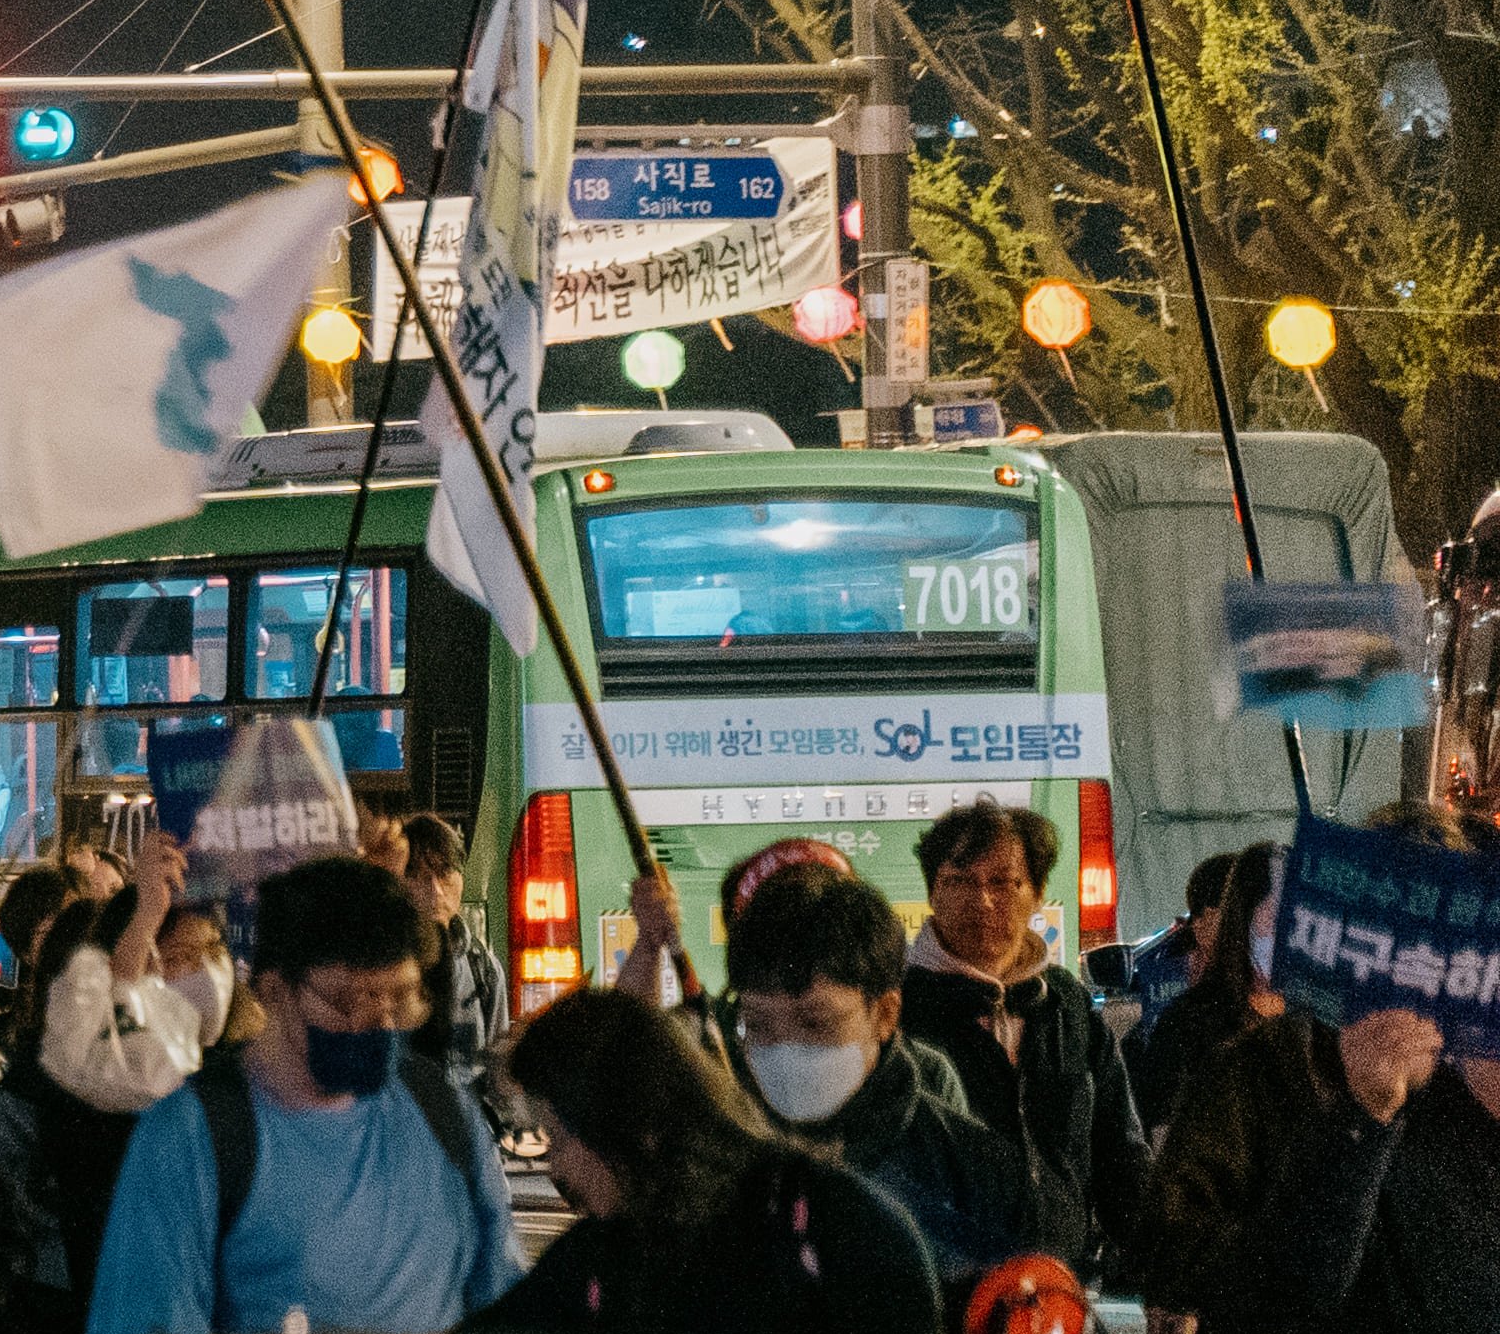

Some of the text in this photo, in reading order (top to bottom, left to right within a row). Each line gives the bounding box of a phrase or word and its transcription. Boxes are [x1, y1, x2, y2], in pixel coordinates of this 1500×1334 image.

[573, 178, 610, 201] 158
[633, 161, 716, 192] 사직로
[738, 177, 776, 199] 162
[638, 196, 713, 218] Sajik-ro
[554, 222, 785, 324] 최선을 다하겠습니다
[908, 564, 1022, 626] 7018
[560, 723, 587, 760] 잘
[590, 731, 658, 759] 이기
[665, 730, 712, 758] 위해
[716, 719, 763, 758] 생긴
[950, 721, 1083, 763] 모임통장
